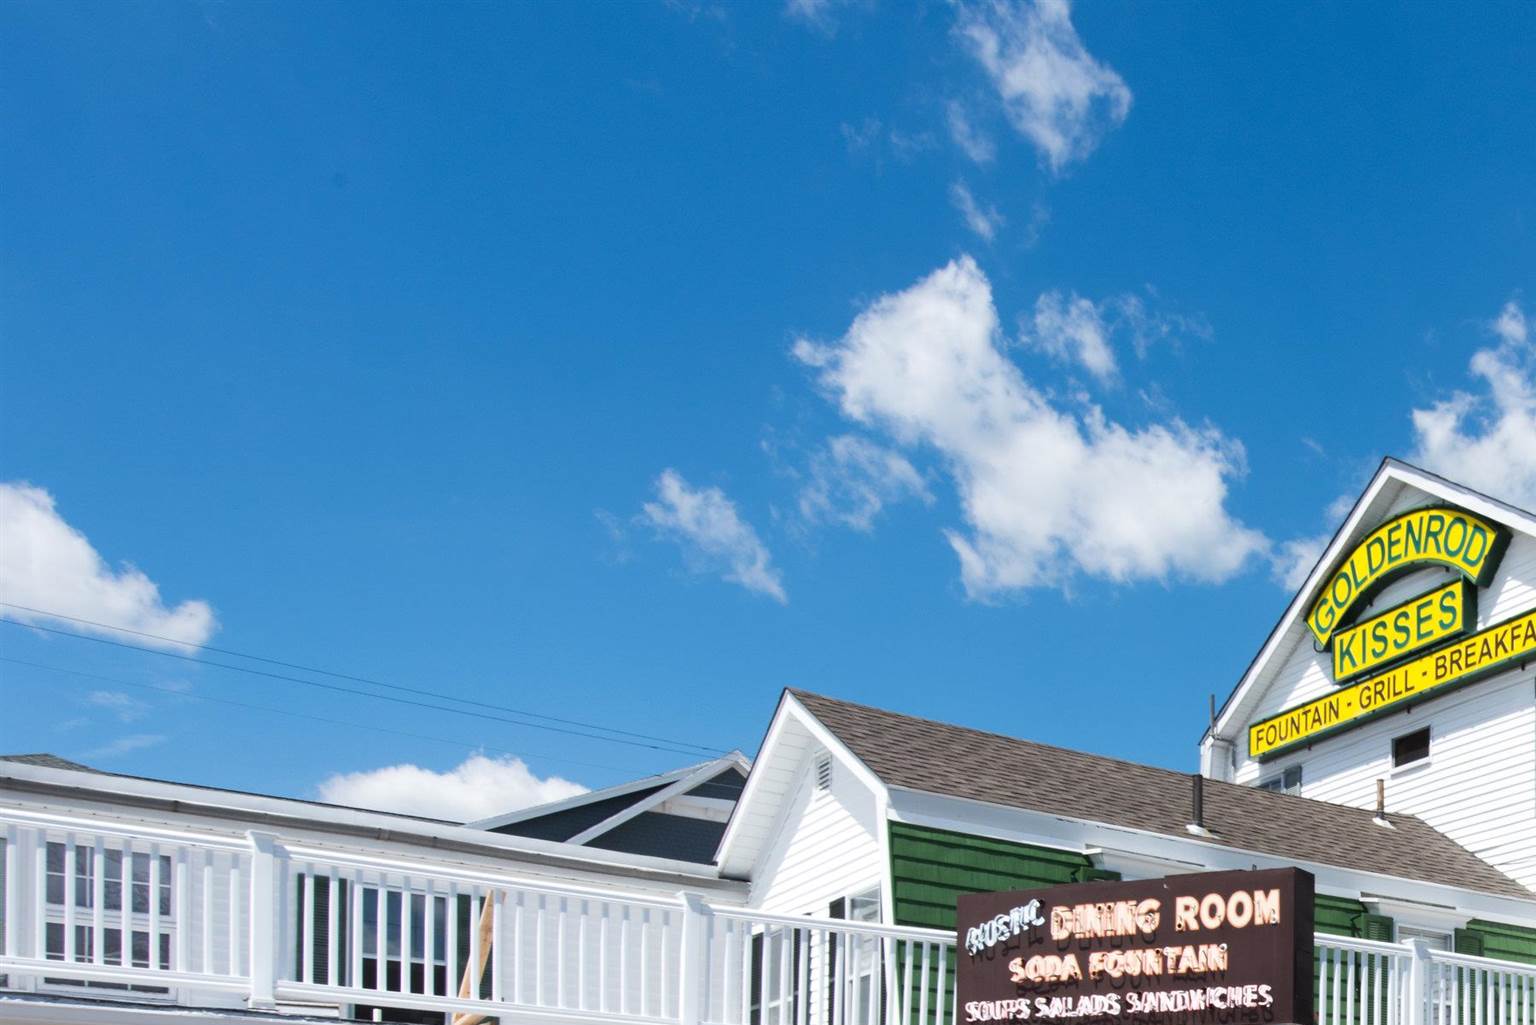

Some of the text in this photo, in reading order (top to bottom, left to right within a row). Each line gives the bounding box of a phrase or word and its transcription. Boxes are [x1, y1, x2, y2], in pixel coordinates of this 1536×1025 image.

[1313, 514, 1489, 635] GOLDENROD
[1338, 589, 1459, 673] KISSES
[1255, 698, 1340, 752] FOUNTAIN
[1358, 670, 1416, 711] GRILL
[965, 889, 1280, 956] RUSTIC DINING ROOM
[1008, 943, 1229, 983] SODA FOUNTAIN
[964, 984, 1274, 1023] SOUPS SALADS SANDWICHES
